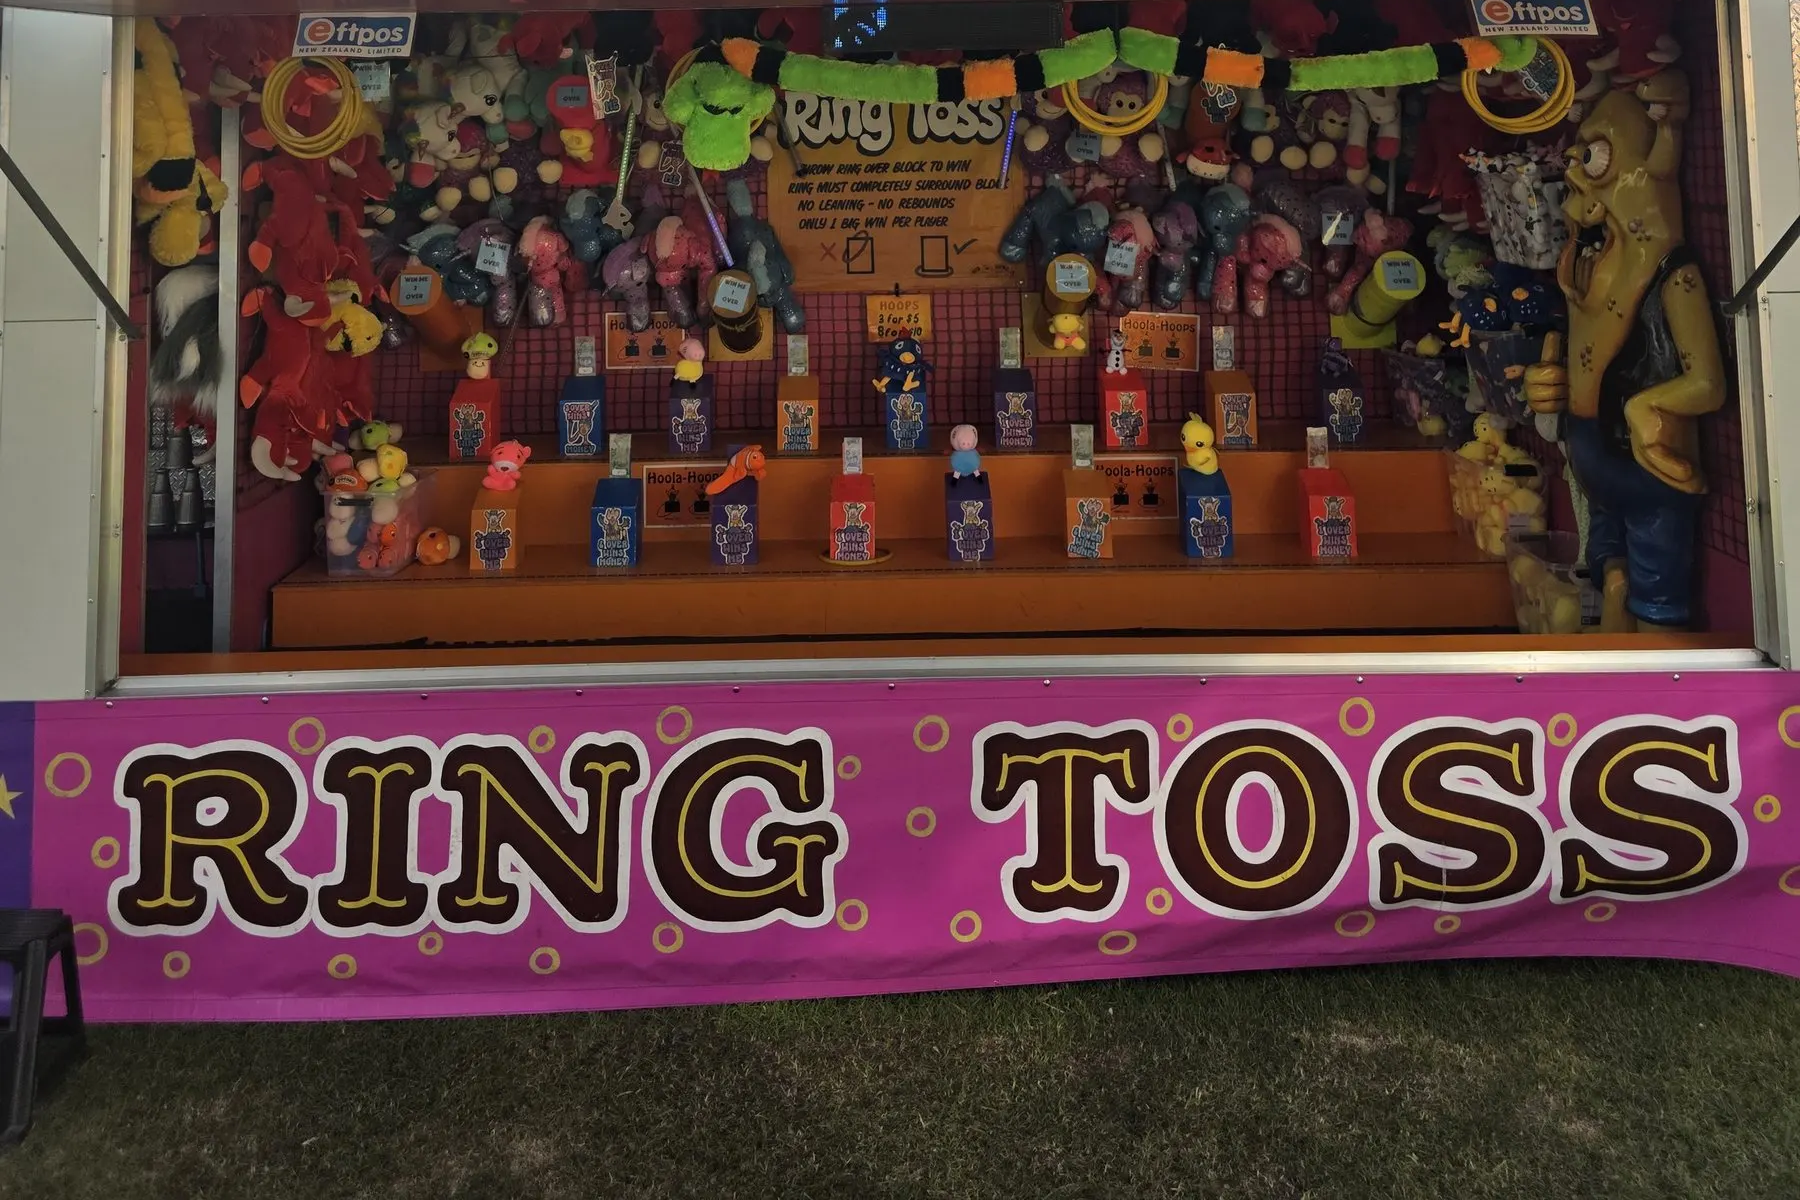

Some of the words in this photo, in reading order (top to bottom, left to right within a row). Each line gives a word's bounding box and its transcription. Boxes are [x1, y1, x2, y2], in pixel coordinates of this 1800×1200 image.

[304, 18, 404, 46] eftpos
[367, 47, 402, 55] LIMITED
[779, 91, 893, 154] Ring
[837, 163, 862, 175] RING
[864, 162, 890, 174] OVER
[893, 161, 927, 173] BLOCK
[930, 161, 943, 173] TO
[946, 159, 972, 173] WIN
[788, 182, 814, 195] RING
[816, 181, 848, 193] MUST
[850, 180, 912, 192] COMPLETELY
[915, 179, 972, 191] SURROUND
[798, 199, 814, 211] NO
[818, 199, 865, 212] LEANING
[877, 199, 894, 210] NO
[898, 197, 956, 210] REBOUNDS
[799, 217, 828, 229] ONLY
[840, 218, 861, 230] BIG
[864, 216, 888, 228] WIN
[892, 216, 912, 228] PER
[914, 216, 949, 228] PLAYER
[722, 296, 739, 305] OVER
[880, 300, 920, 311] HOOPS
[878, 313, 884, 324] 3
[887, 313, 903, 324] for
[906, 312, 919, 324] $5
[1124, 319, 1196, 333] Hoola-Hoops
[1009, 419, 1031, 428] OVER
[1006, 428, 1027, 437] WINS
[1003, 437, 1031, 446] MONEY
[1096, 465, 1174, 477] oola-Hoops
[648, 471, 723, 485] Hoola-Hoop
[845, 532, 868, 541] OVER
[606, 540, 628, 549] OVER
[840, 541, 865, 551] WINS
[603, 549, 625, 557] WINS
[837, 551, 868, 560] MONEY
[963, 550, 978, 560] ME
[599, 557, 628, 566] MONEY
[728, 554, 742, 563] ME
[112, 731, 844, 932] RING
[975, 719, 1744, 918] TOSS
